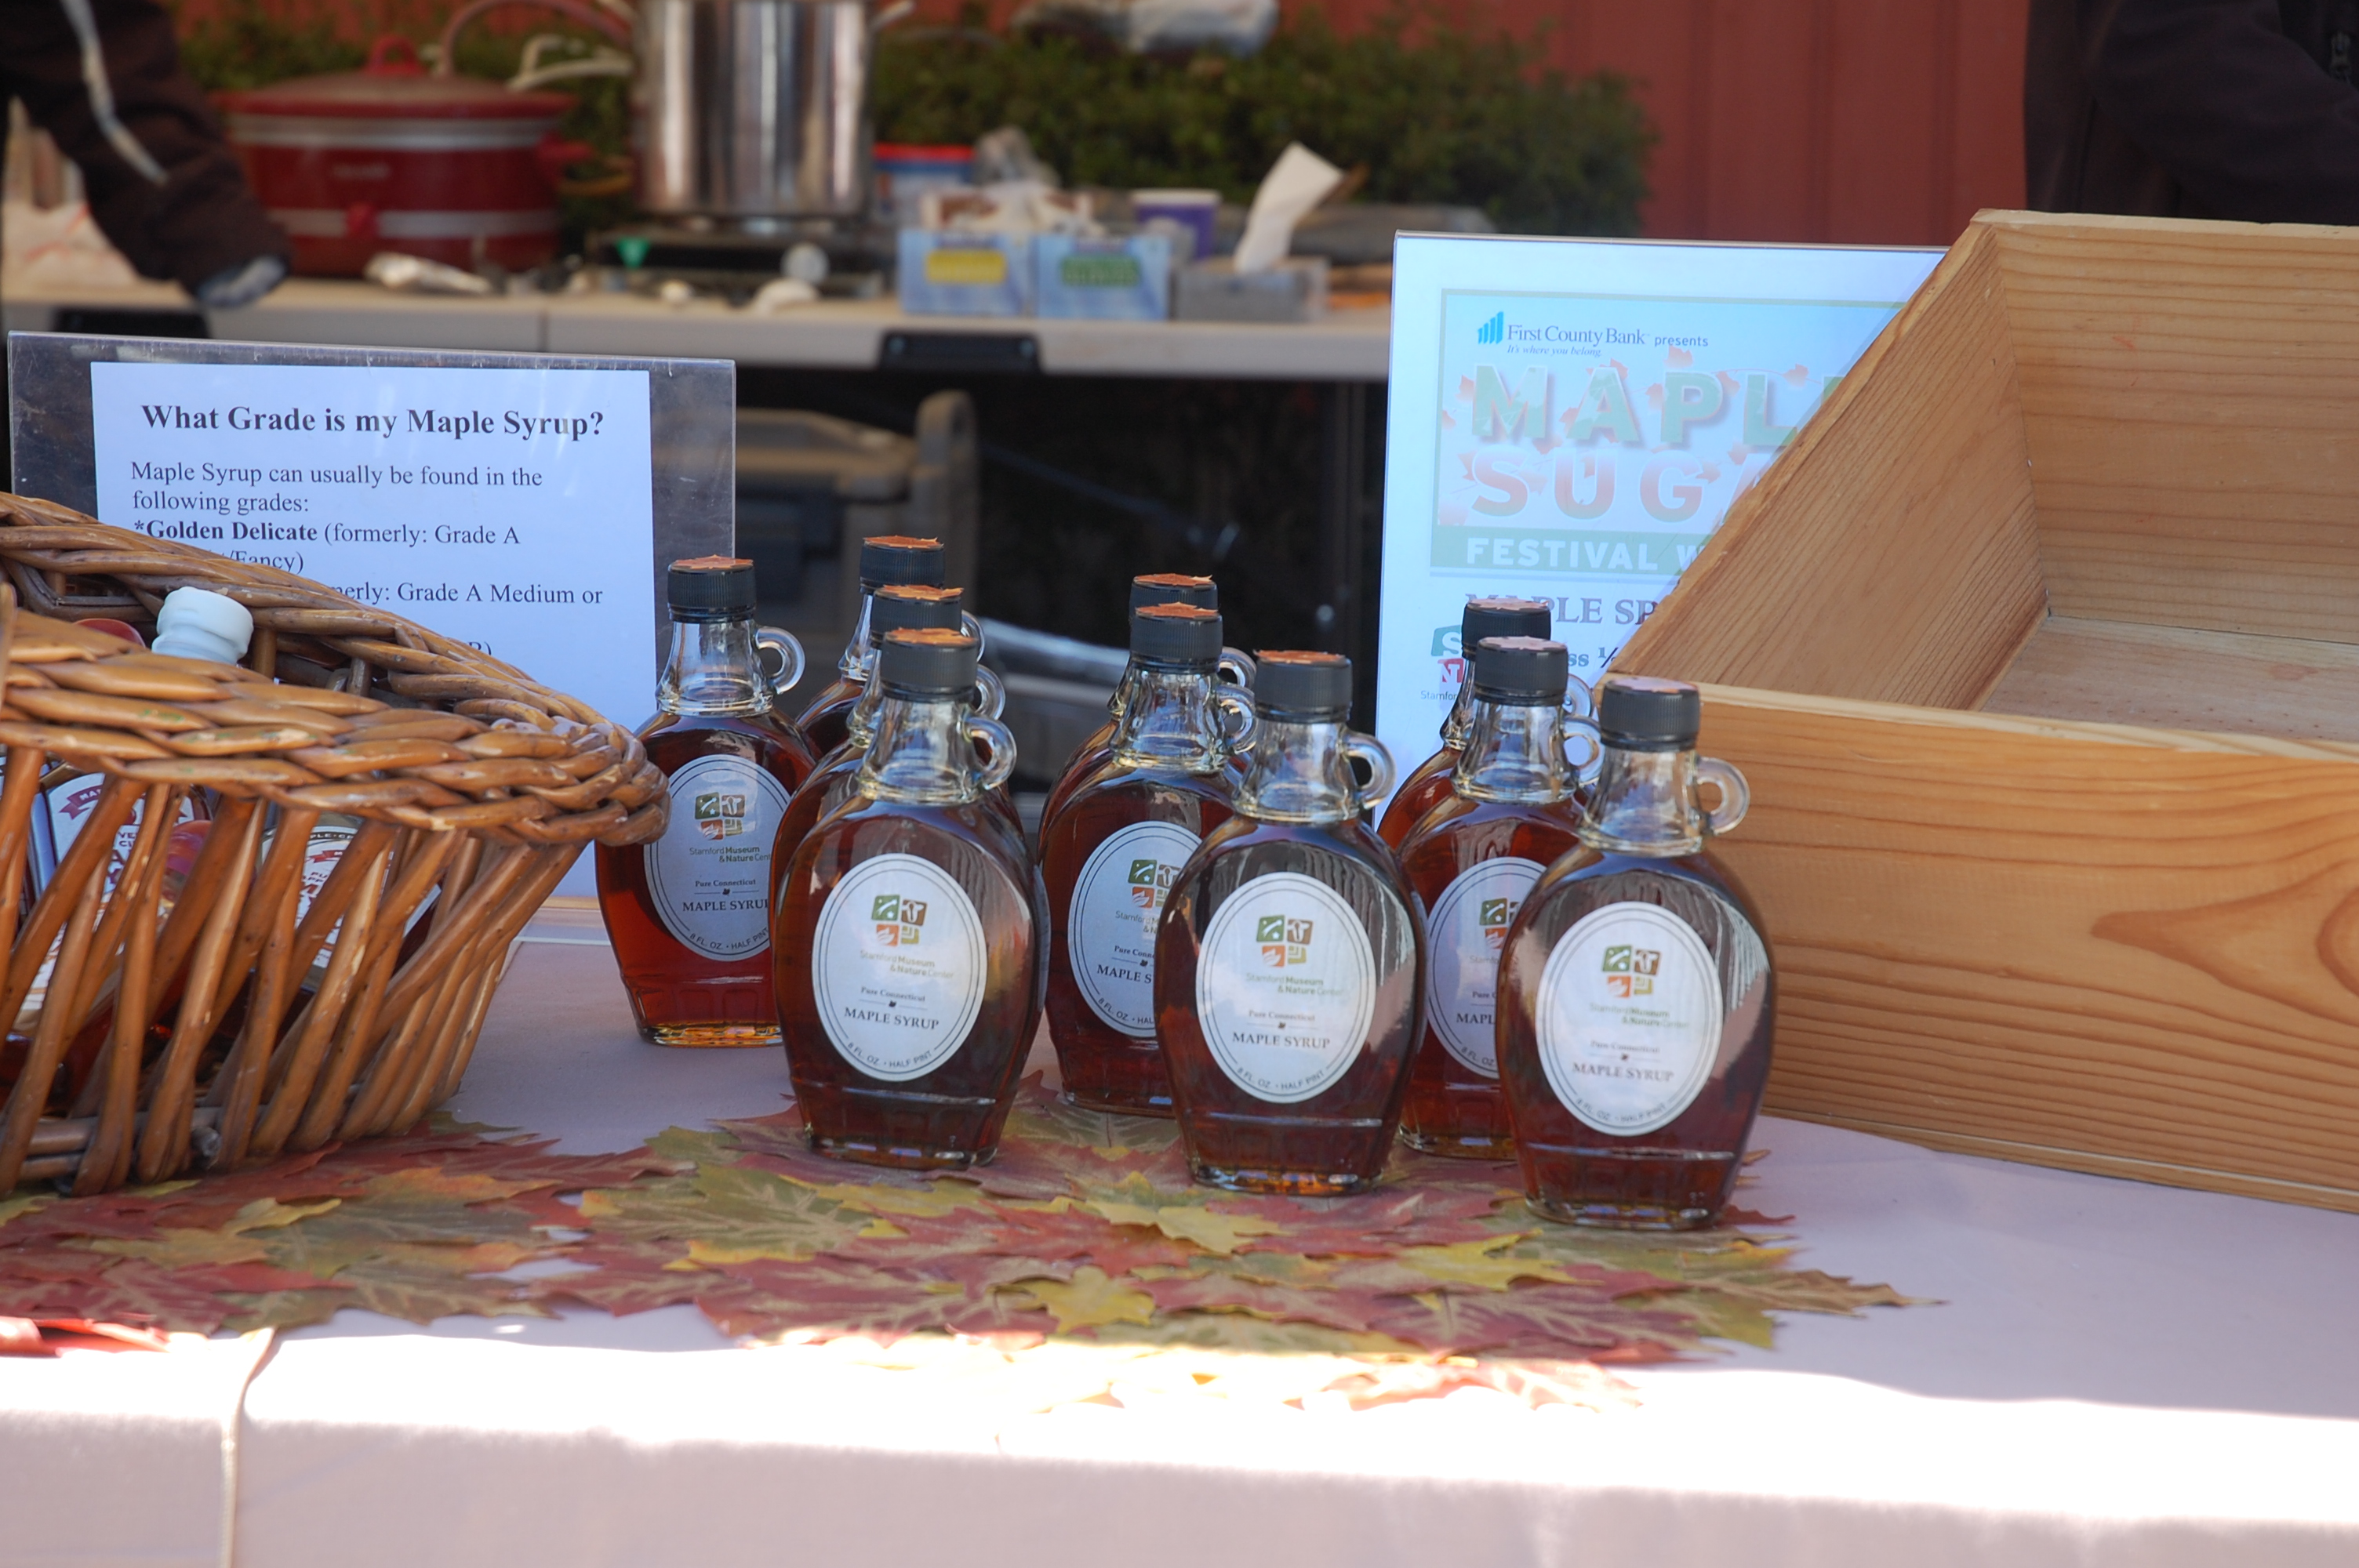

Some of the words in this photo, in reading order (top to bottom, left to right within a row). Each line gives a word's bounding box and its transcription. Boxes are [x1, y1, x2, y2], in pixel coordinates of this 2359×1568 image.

[1507, 325, 1542, 342] First
[1545, 325, 1603, 347] County
[1606, 328, 1646, 345] Bank
[1655, 335, 1709, 347] presents
[1507, 345, 1520, 354] It's
[1523, 345, 1549, 354] where
[1552, 347, 1568, 356] you
[1571, 346, 1602, 358] belong.
[141, 405, 219, 430] What
[227, 406, 316, 431] Grade
[325, 408, 345, 432] is
[355, 414, 398, 438] my
[406, 408, 496, 440] Maple
[503, 410, 604, 441] Syrup?
[131, 461, 195, 485] Maple
[202, 463, 263, 487] Syrup
[268, 468, 303, 483] can
[310, 465, 383, 488] usually
[391, 465, 413, 485] be
[420, 466, 479, 485] found
[485, 467, 504, 485] in
[511, 467, 543, 486] the
[133, 490, 231, 515] following
[237, 493, 309, 516] grades:
[231, 521, 318, 541] Delicate
[324, 522, 427, 548] (formerly:
[434, 524, 496, 544] Grade
[503, 526, 522, 544] A
[1467, 537, 1658, 572] FESTIVAL
[397, 582, 459, 602] Grade
[466, 584, 483, 603] A
[489, 584, 575, 604] Medium
[581, 590, 603, 604] or
[689, 847, 725, 855] Stamford
[725, 854, 754, 862] Nature
[754, 853, 771, 862] Cent
[682, 901, 726, 912] MAPLE
[1115, 910, 1150, 924] Stamford
[731, 938, 751, 950] HALF
[753, 927, 769, 942] PINT
[860, 949, 897, 963] Stamford
[898, 956, 935, 968] Museum
[1114, 946, 1131, 955] Pure
[897, 965, 927, 977] Nature
[1097, 964, 1141, 982] MAPLE
[1246, 973, 1285, 982] Stamford
[1285, 974, 1324, 986] Museum
[861, 986, 878, 995] Pure
[880, 989, 925, 1002] Connecticut
[1285, 985, 1315, 995] Nature
[845, 1007, 890, 1025] MAPLE
[894, 1015, 940, 1030] SYRUP
[1456, 1013, 1495, 1025] MAPL
[1232, 1032, 1281, 1046] MAPLE
[1284, 1036, 1331, 1049] SYRUP
[889, 1059, 911, 1068] HALF
[914, 1050, 932, 1065] PINT
[1281, 1081, 1303, 1090] HALF
[1306, 1070, 1325, 1084] PINT
[1572, 1062, 1623, 1077] MAPLE
[1627, 1068, 1674, 1083] SYRUP
